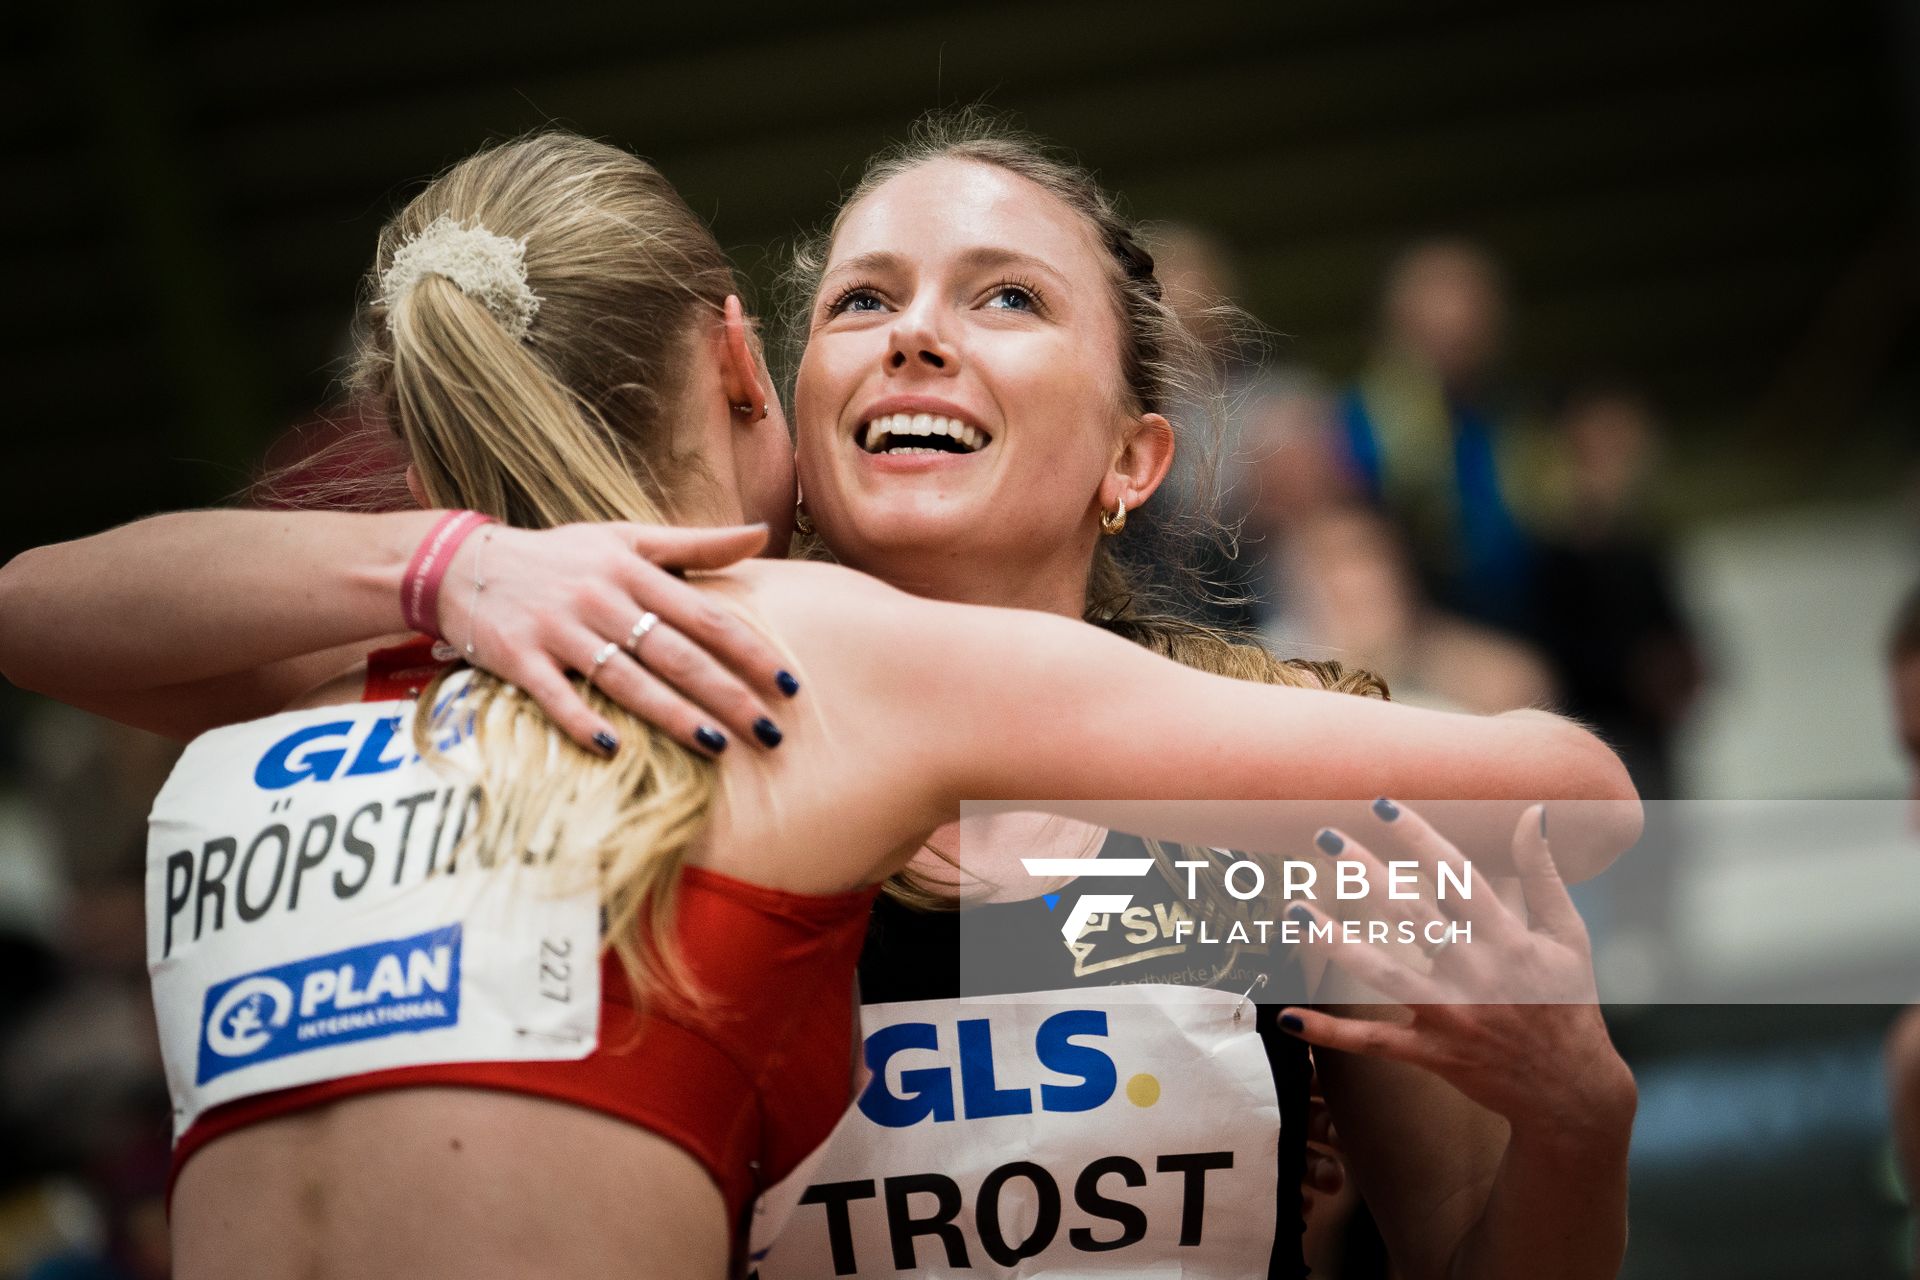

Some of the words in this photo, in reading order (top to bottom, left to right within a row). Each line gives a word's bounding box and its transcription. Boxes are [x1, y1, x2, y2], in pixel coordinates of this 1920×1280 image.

[300, 944, 450, 1017] PLAN
[539, 937, 571, 1004] 227
[297, 1000, 448, 1040] INTERNATIONAL
[797, 1151, 1234, 1276] TROST
